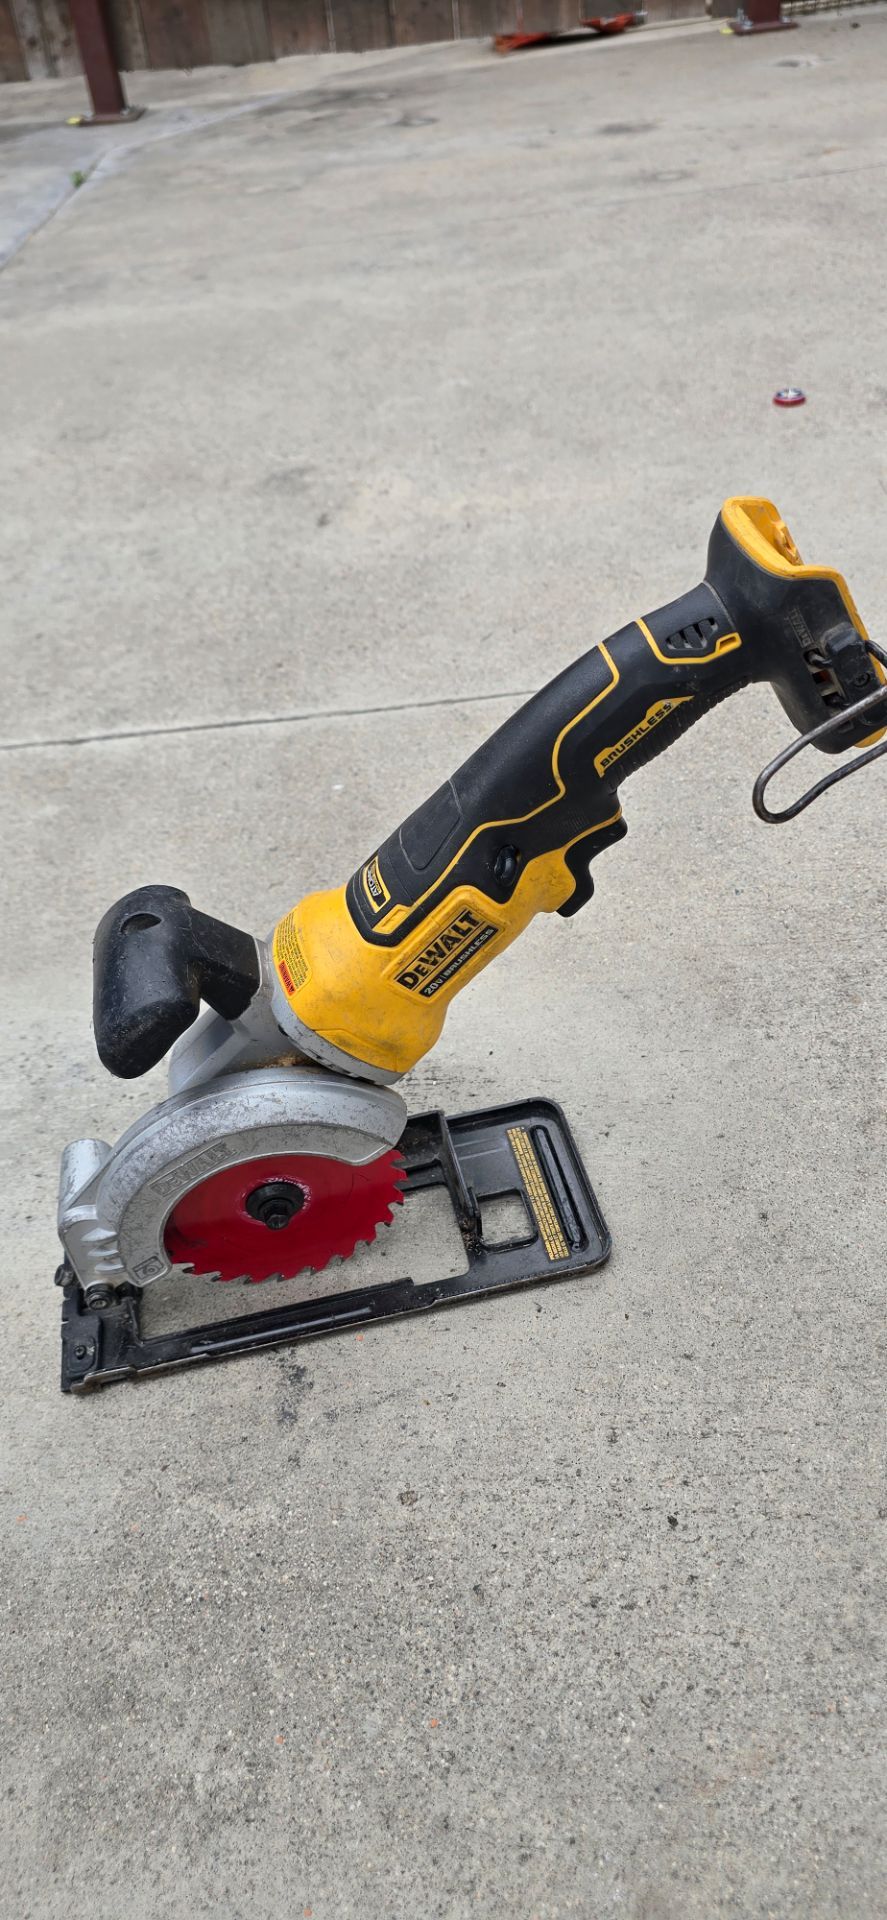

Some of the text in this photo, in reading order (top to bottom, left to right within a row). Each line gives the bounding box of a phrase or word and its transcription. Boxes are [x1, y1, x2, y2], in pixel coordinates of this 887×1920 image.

[600, 702, 673, 767] BRUSHLESS
[397, 911, 480, 989] DEWALT
[424, 929, 494, 995] 20V BRUSHLESS
